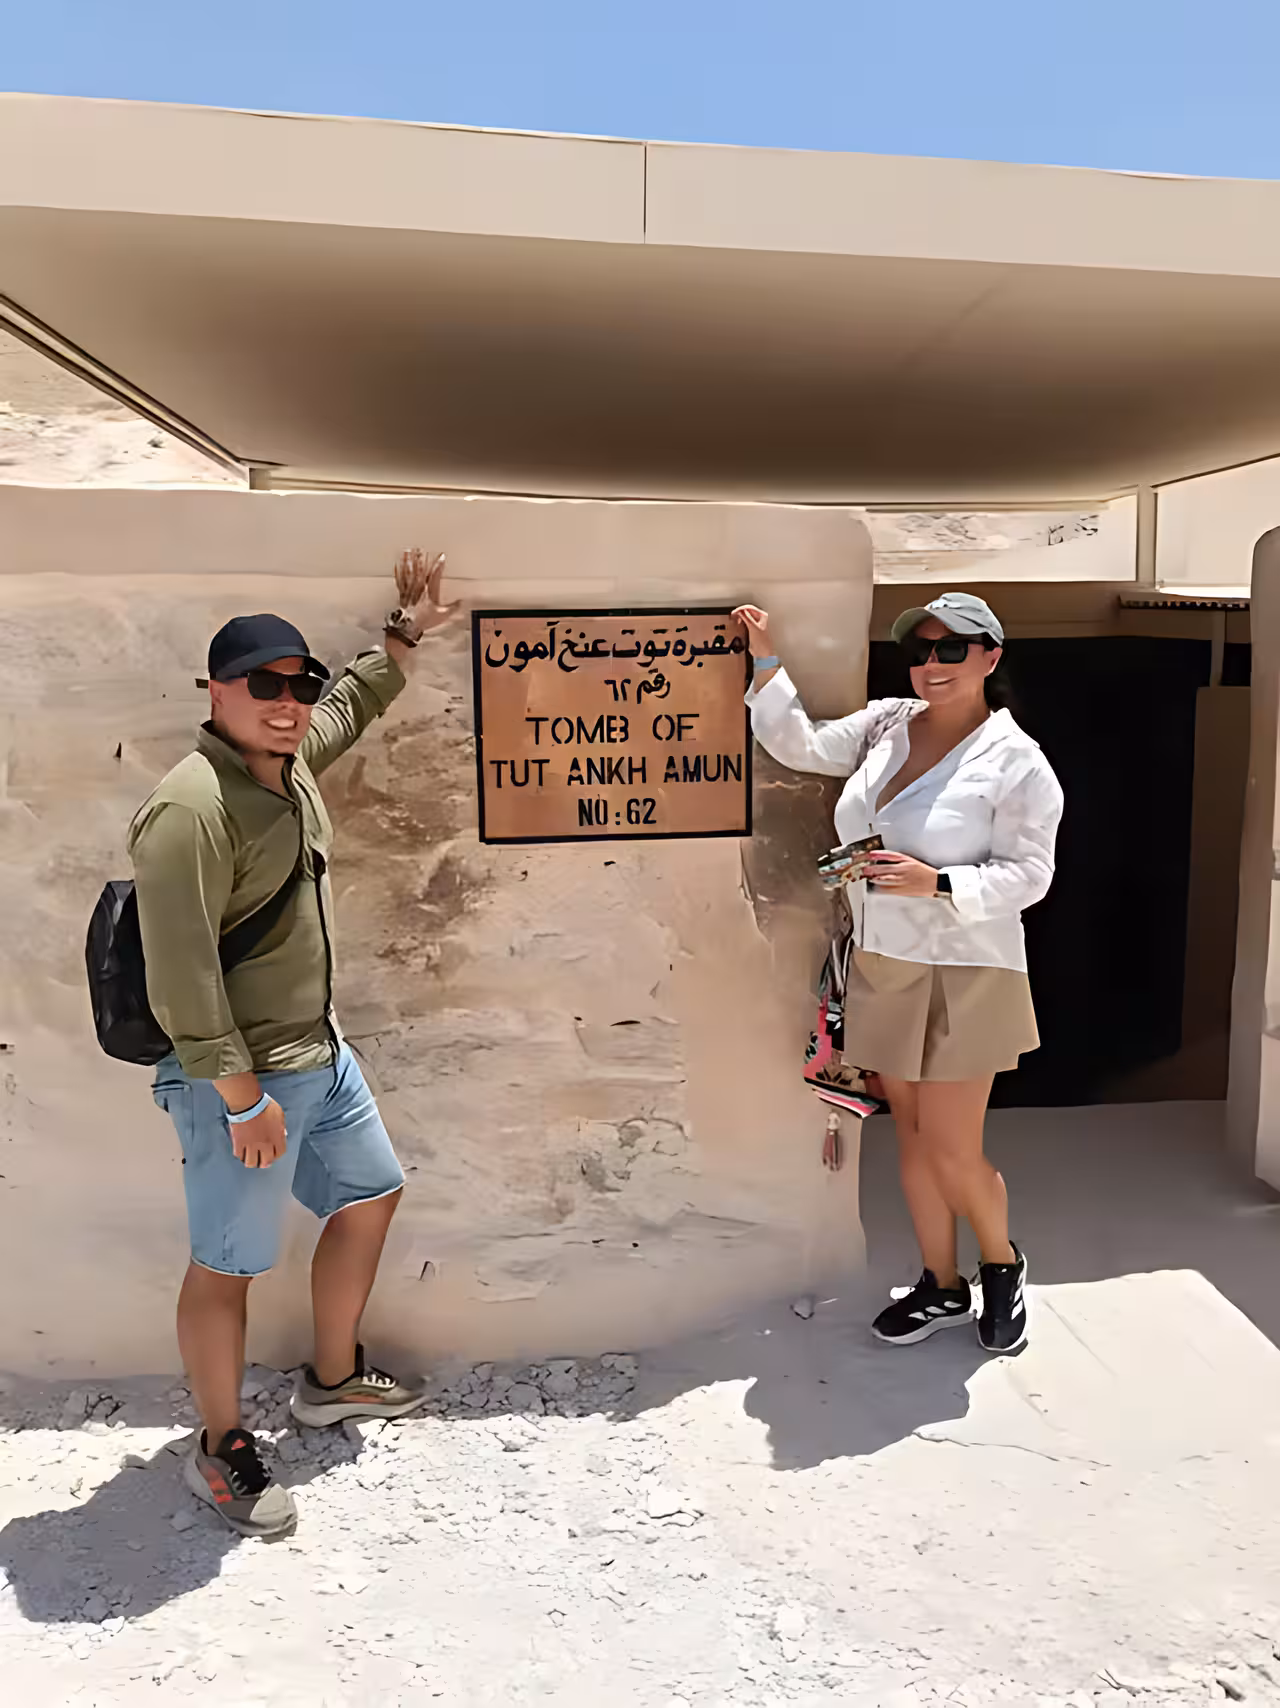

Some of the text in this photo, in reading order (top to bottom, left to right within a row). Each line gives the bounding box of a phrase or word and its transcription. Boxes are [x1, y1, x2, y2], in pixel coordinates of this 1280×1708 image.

[557, 628, 610, 672] عنخ
[612, 629, 671, 668] توت
[672, 624, 745, 668] مقبرة
[636, 667, 671, 704] رقم
[525, 713, 700, 745] TOMB OF
[489, 753, 742, 788] TUT ANKH AMUN
